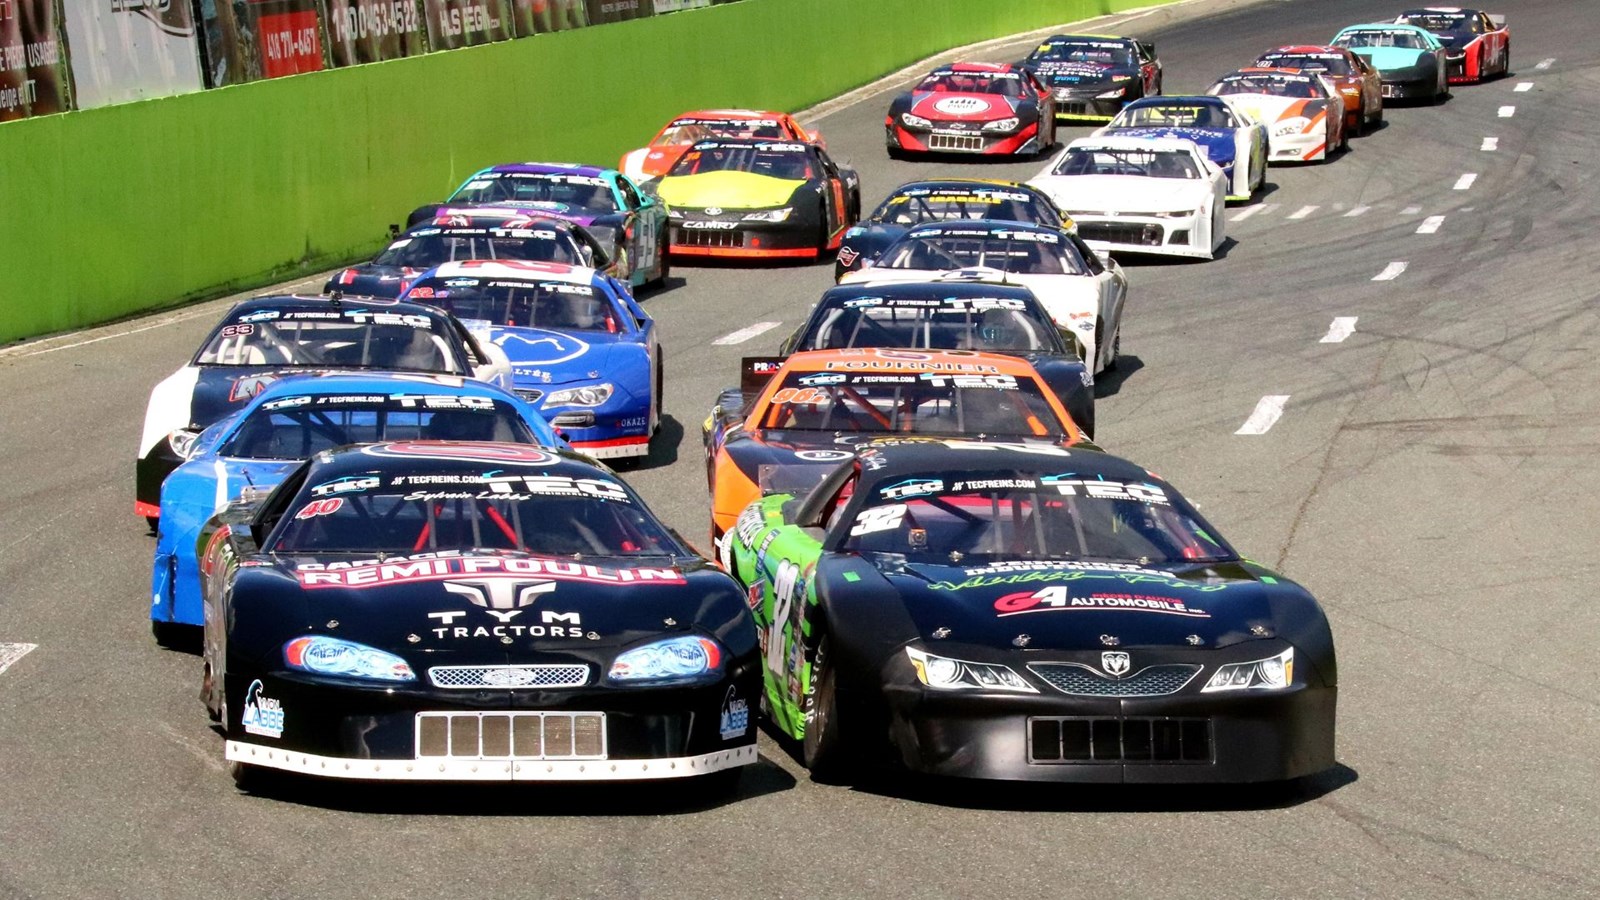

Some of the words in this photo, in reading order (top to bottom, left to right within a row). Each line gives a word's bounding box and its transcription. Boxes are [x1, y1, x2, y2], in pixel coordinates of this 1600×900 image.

[682, 220, 739, 230] CAMRY
[540, 283, 593, 296] TEC
[944, 298, 1026, 311] TEC
[345, 311, 432, 327] TEC
[221, 324, 254, 337] 33
[826, 360, 998, 373] FOURNIER
[863, 376, 916, 384] TECFREINS.COM
[920, 375, 1018, 387] TEC
[389, 394, 494, 407] TEC
[621, 416, 646, 427] OKAZE
[311, 476, 380, 497] TEC
[407, 475, 483, 485] TECFREINS.COM
[482, 475, 629, 499] TEC
[880, 480, 944, 500] TEC
[965, 479, 1037, 489] TECFREINS.COM
[1041, 479, 1168, 502] TEC
[295, 497, 344, 520] 40
[850, 503, 907, 537] 32
[297, 549, 460, 571] GARAGE
[303, 558, 448, 586] REMI
[463, 557, 678, 582] POULIN
[1071, 597, 1187, 612] AUTOMOBILE
[428, 610, 581, 624] TYM
[432, 625, 583, 639] TRACTORS
